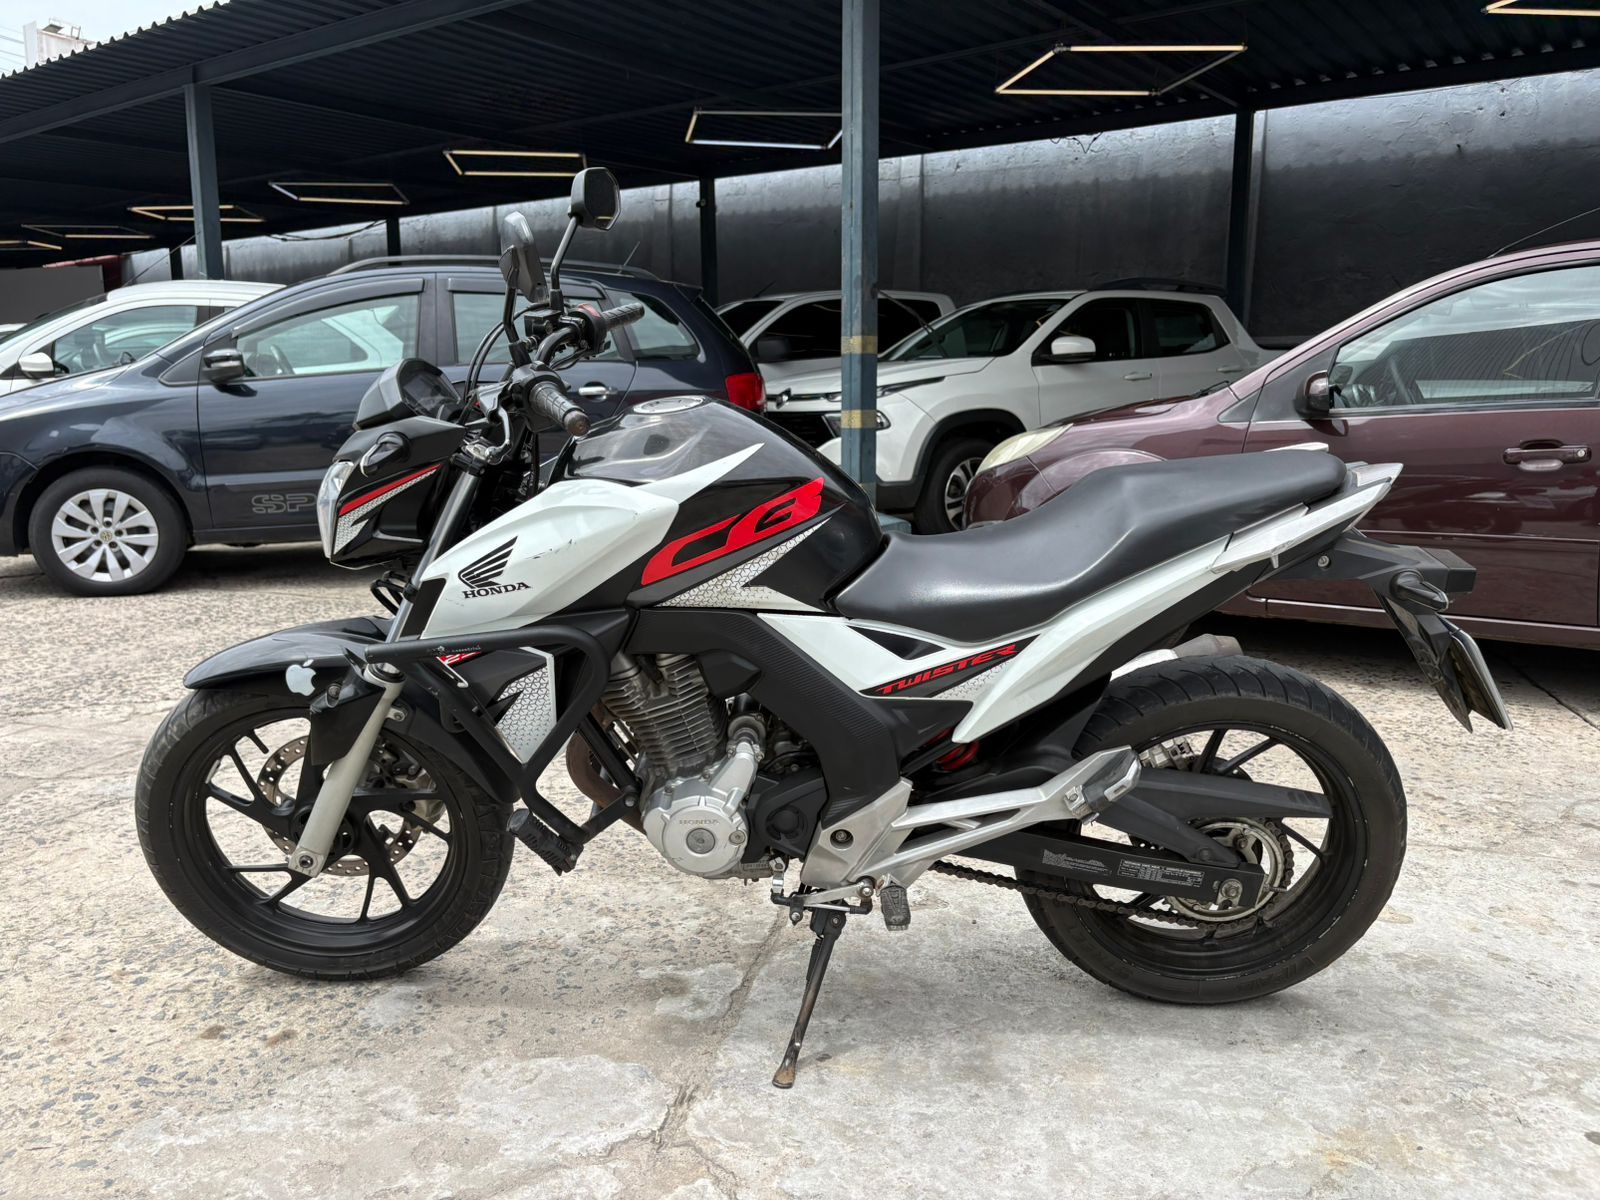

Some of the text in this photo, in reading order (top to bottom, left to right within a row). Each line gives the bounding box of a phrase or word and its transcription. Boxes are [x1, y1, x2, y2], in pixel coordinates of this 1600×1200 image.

[641, 477, 825, 586] CB
[462, 582, 531, 599] HONDA
[876, 645, 1018, 695] TWISTER
